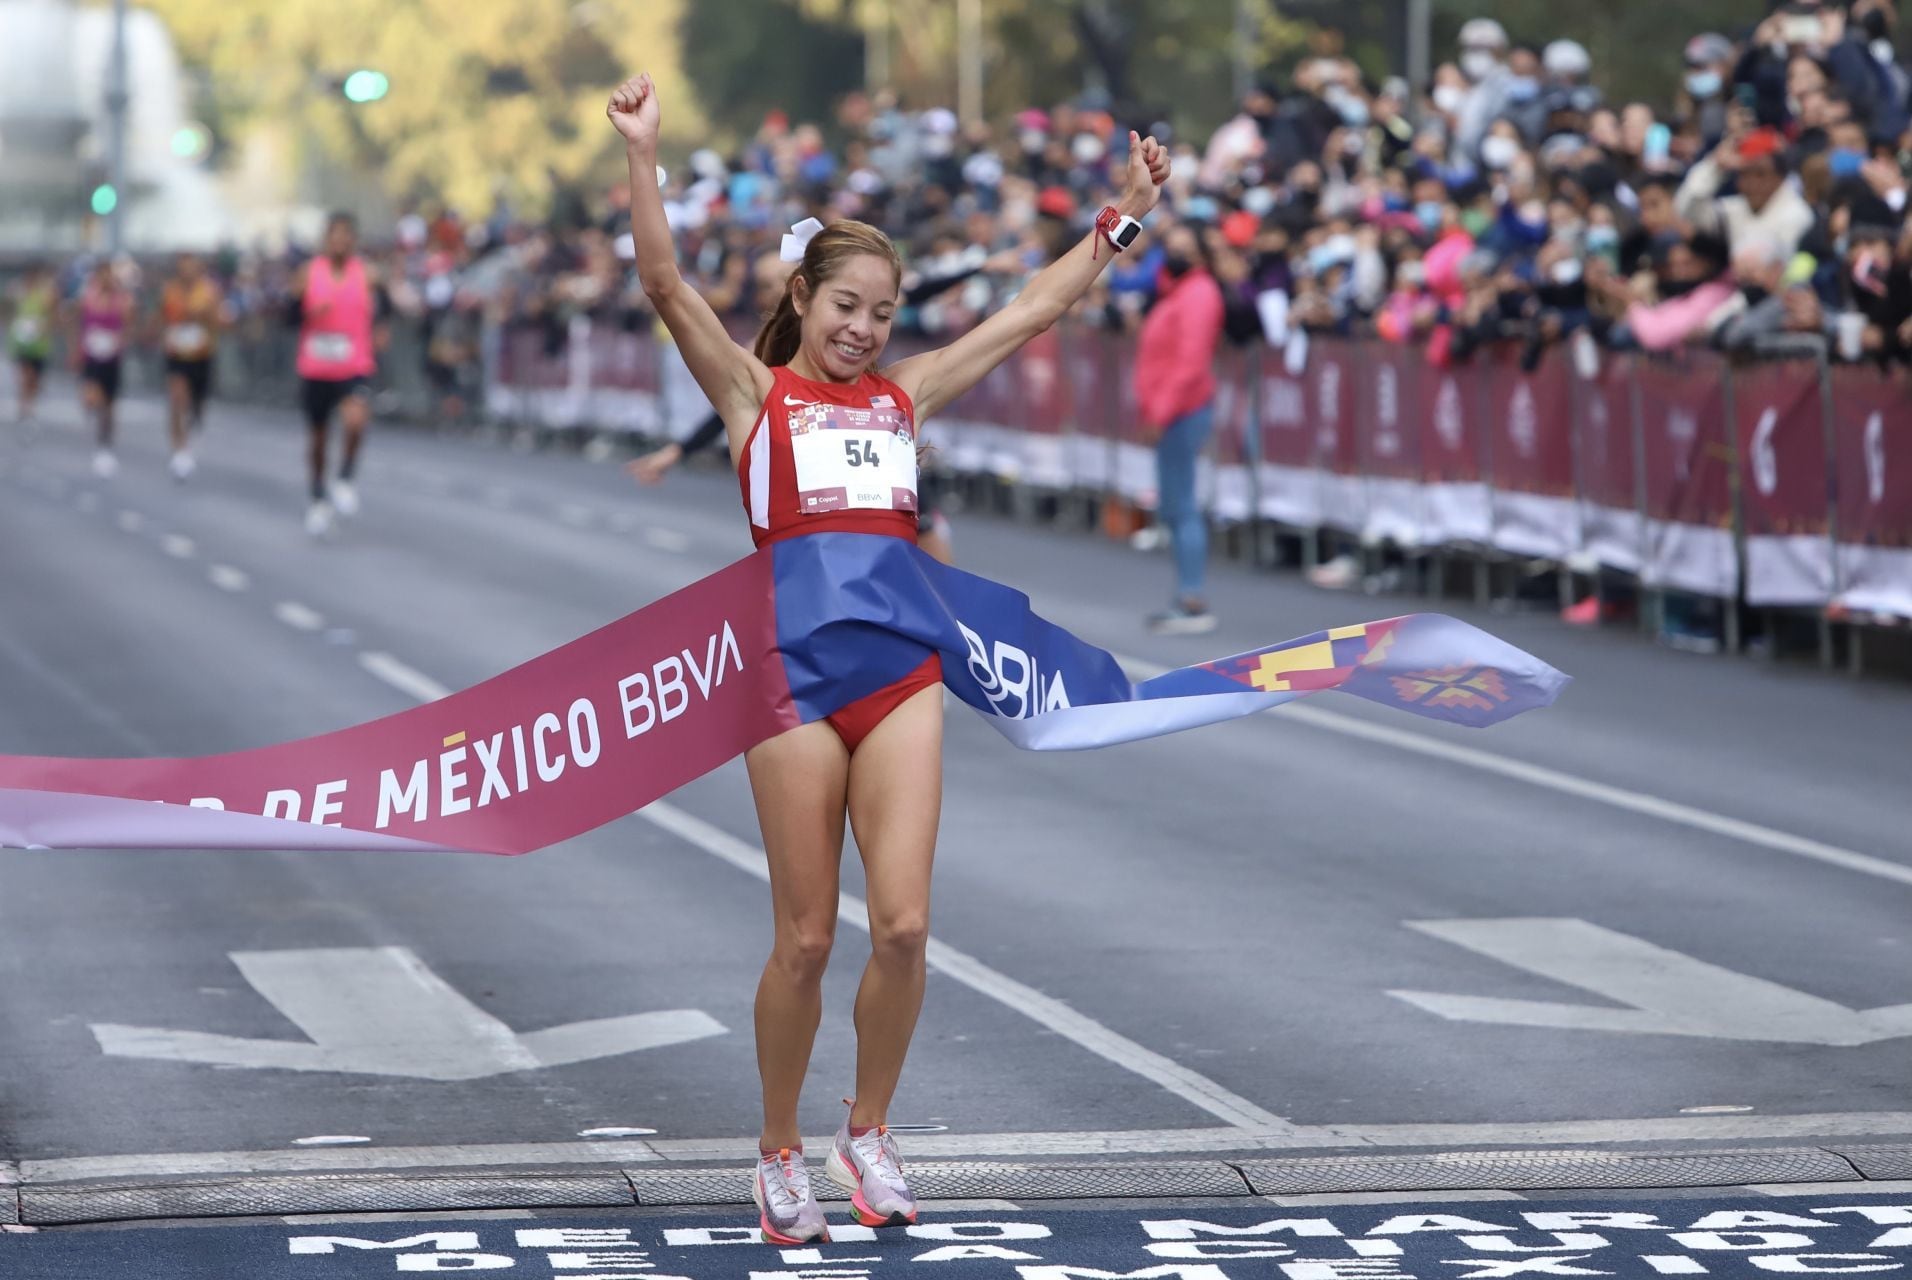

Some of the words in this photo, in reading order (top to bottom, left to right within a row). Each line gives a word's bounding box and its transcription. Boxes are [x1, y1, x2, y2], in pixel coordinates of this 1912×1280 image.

[844, 439, 880, 467] 54
[857, 493, 883, 502] BBVA
[956, 619, 1072, 721] BBVA
[375, 697, 601, 829] MÉXICO
[618, 619, 744, 740] BBVA
[288, 1222, 1054, 1255] MEDIO
[396, 1252, 656, 1272] DE
[778, 1245, 1044, 1265] LA
[1141, 1226, 1912, 1259] CIUD
